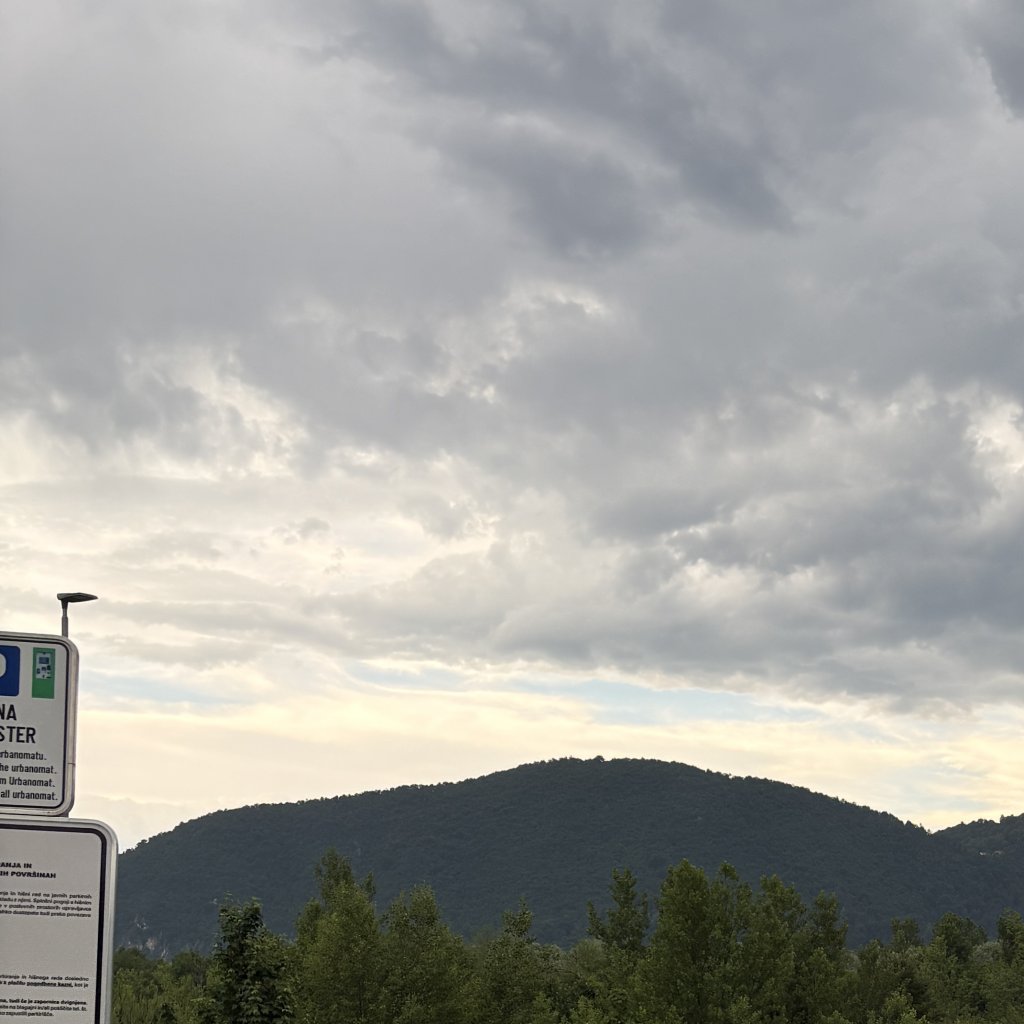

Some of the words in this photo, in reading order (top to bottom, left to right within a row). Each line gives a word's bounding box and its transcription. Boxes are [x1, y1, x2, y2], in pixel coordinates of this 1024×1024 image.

[0, 749, 47, 760] rbanomatu.
[11, 764, 57, 774] urbanomat.
[9, 776, 56, 787] Urbanomat.
[12, 790, 58, 801] urbanomat.
